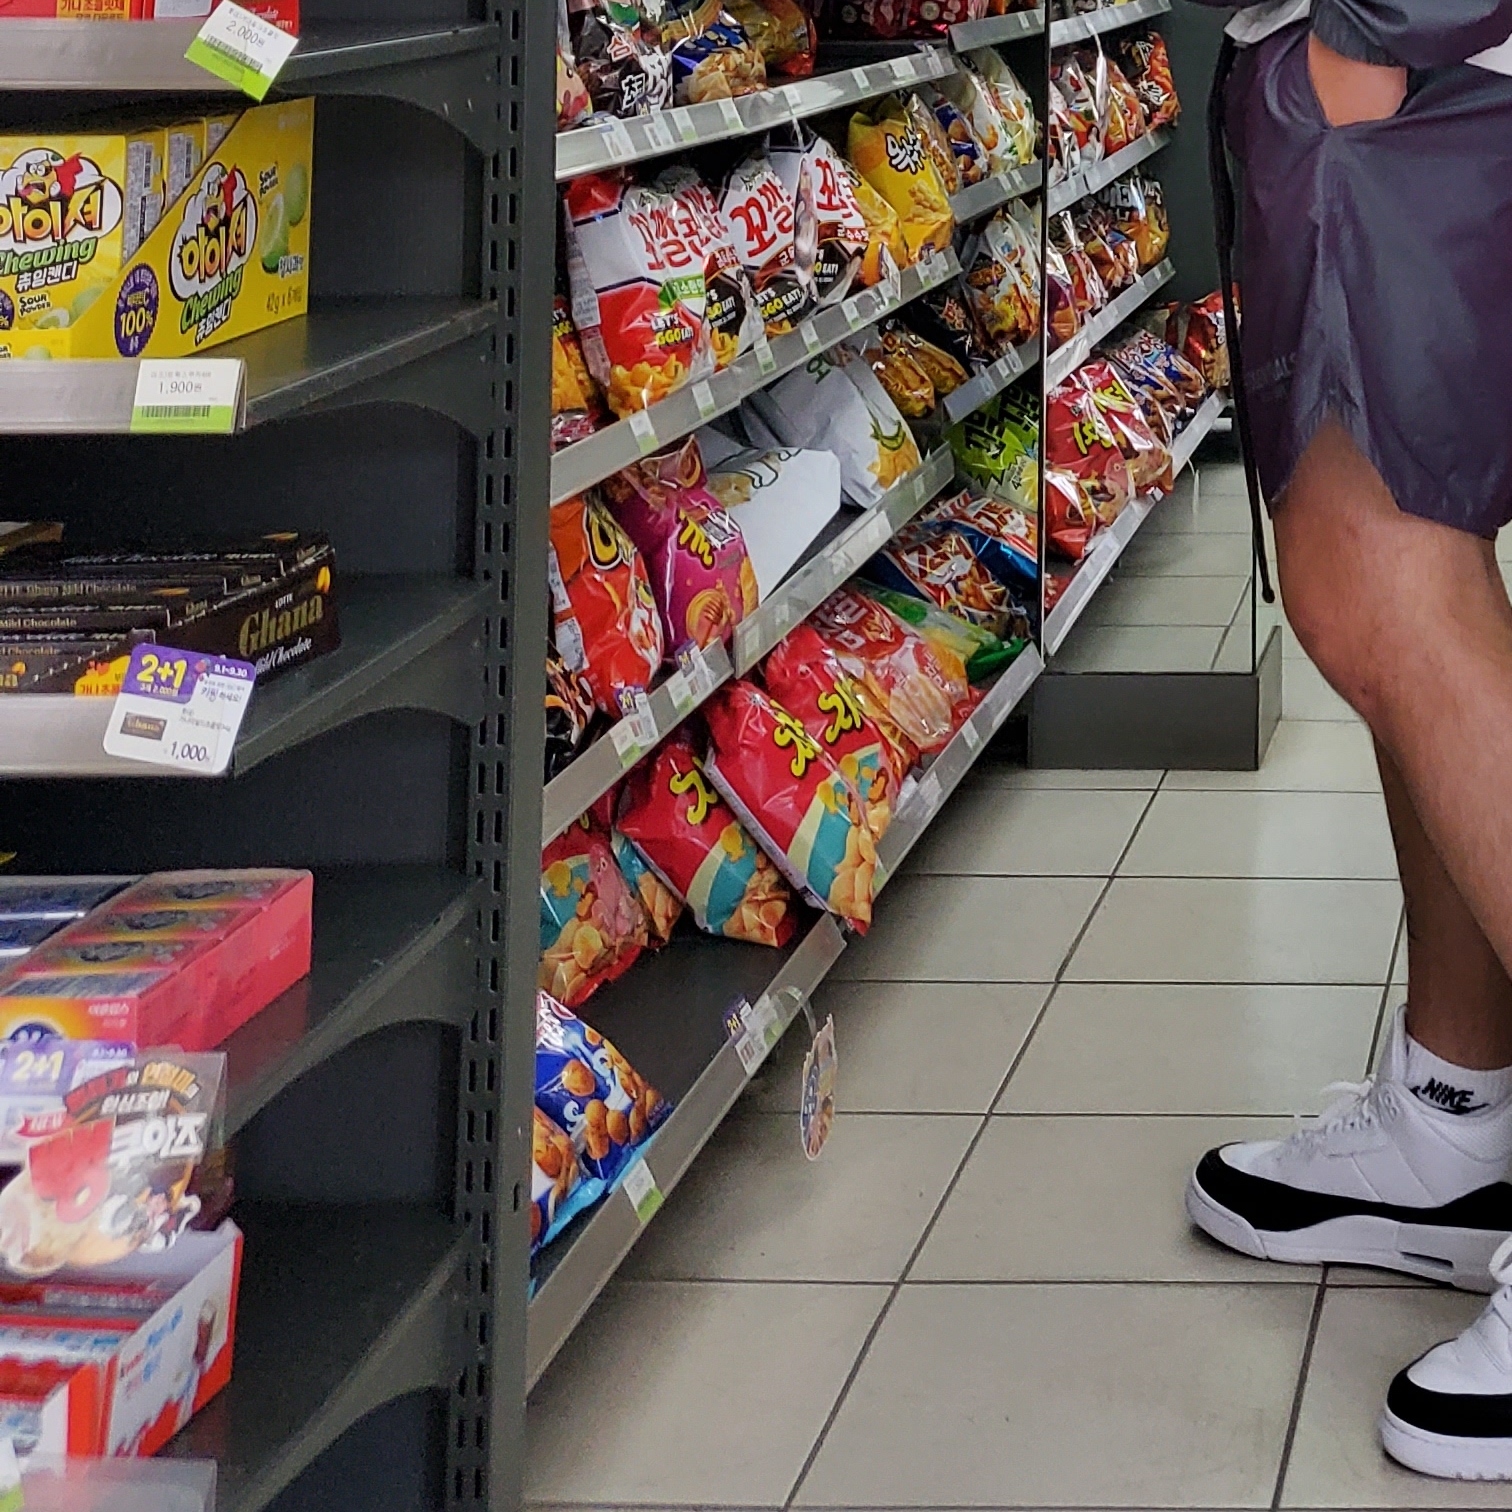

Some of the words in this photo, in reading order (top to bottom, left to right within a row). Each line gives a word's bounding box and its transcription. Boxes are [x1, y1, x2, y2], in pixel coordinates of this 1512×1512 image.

[0, 184, 104, 244] 아이셔
[179, 199, 248, 283] 아이셔
[19, 294, 48, 309] SOUR
[120, 306, 154, 338] 100%
[180, 264, 244, 335] Chewing
[238, 593, 324, 657] Ghana
[137, 654, 188, 688] 2+1
[1424, 1077, 1475, 1108] NIKE
